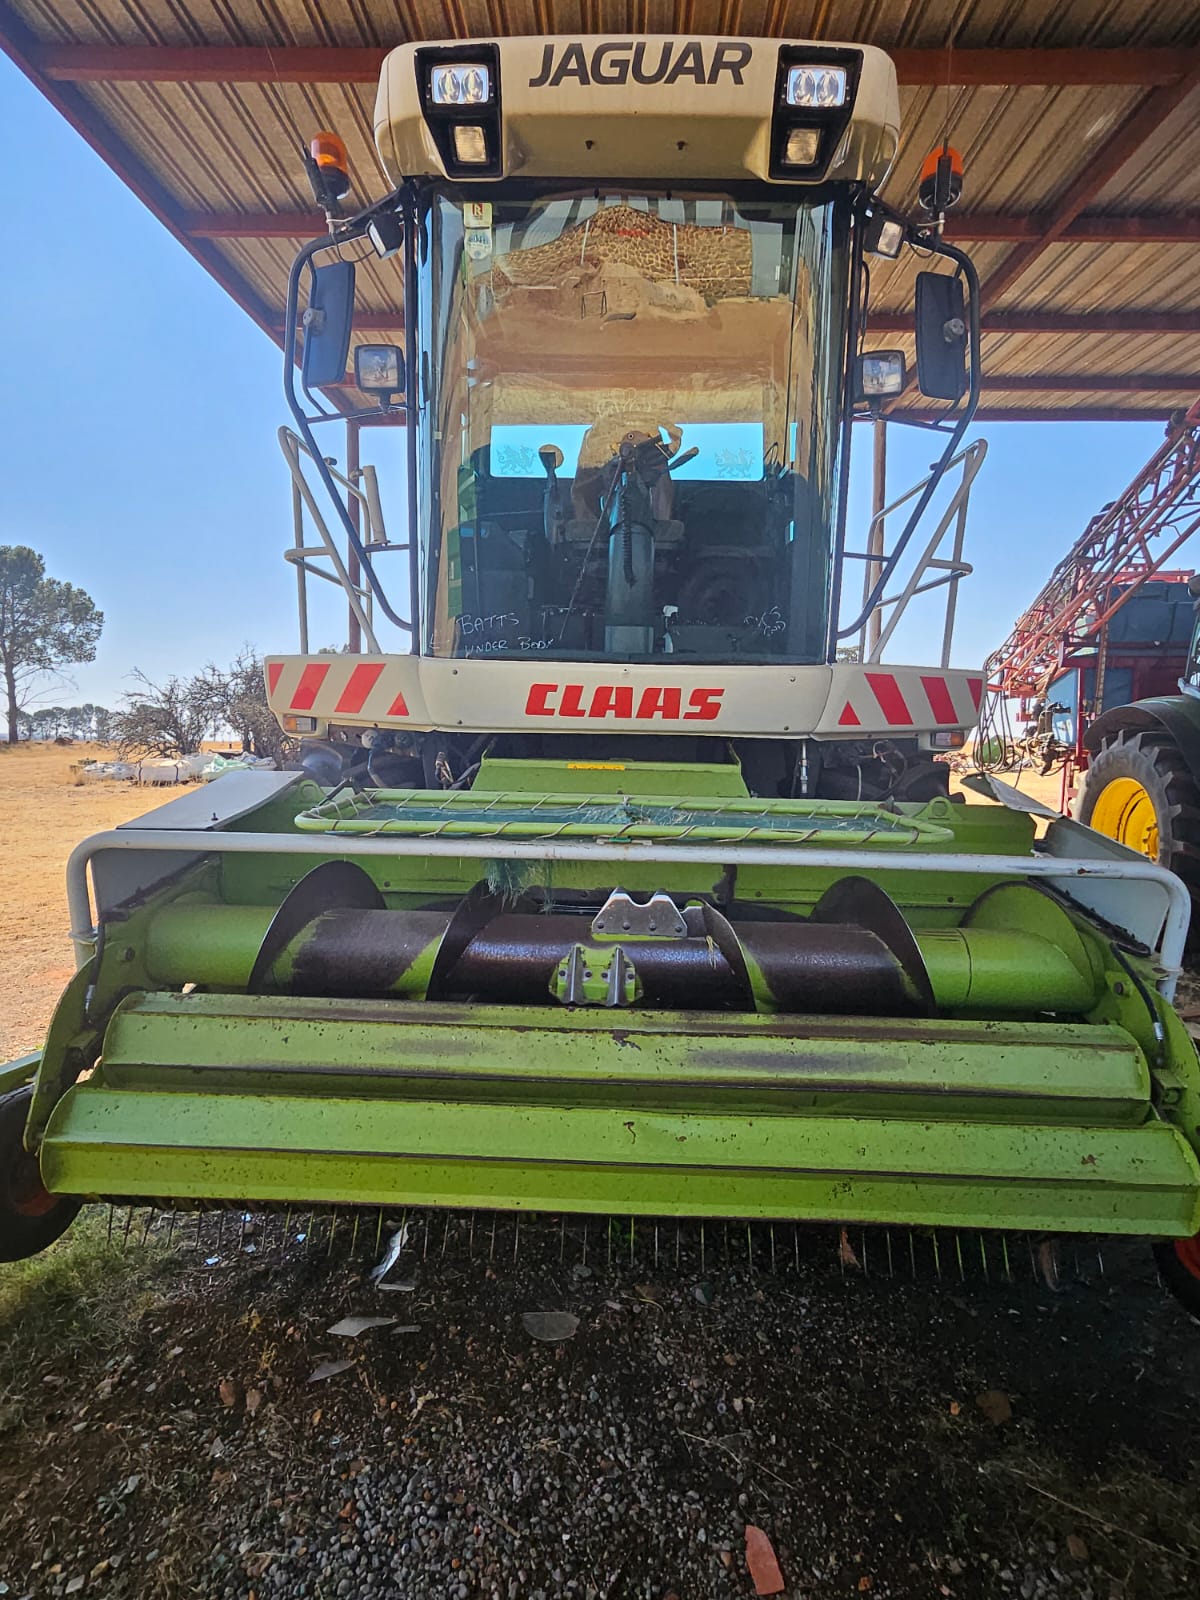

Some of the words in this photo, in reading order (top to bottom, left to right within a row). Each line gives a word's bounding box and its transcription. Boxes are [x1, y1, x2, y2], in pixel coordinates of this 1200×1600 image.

[529, 41, 753, 88] JAGUAR
[456, 613, 519, 635] BATTS
[526, 684, 724, 720] CLAAS
